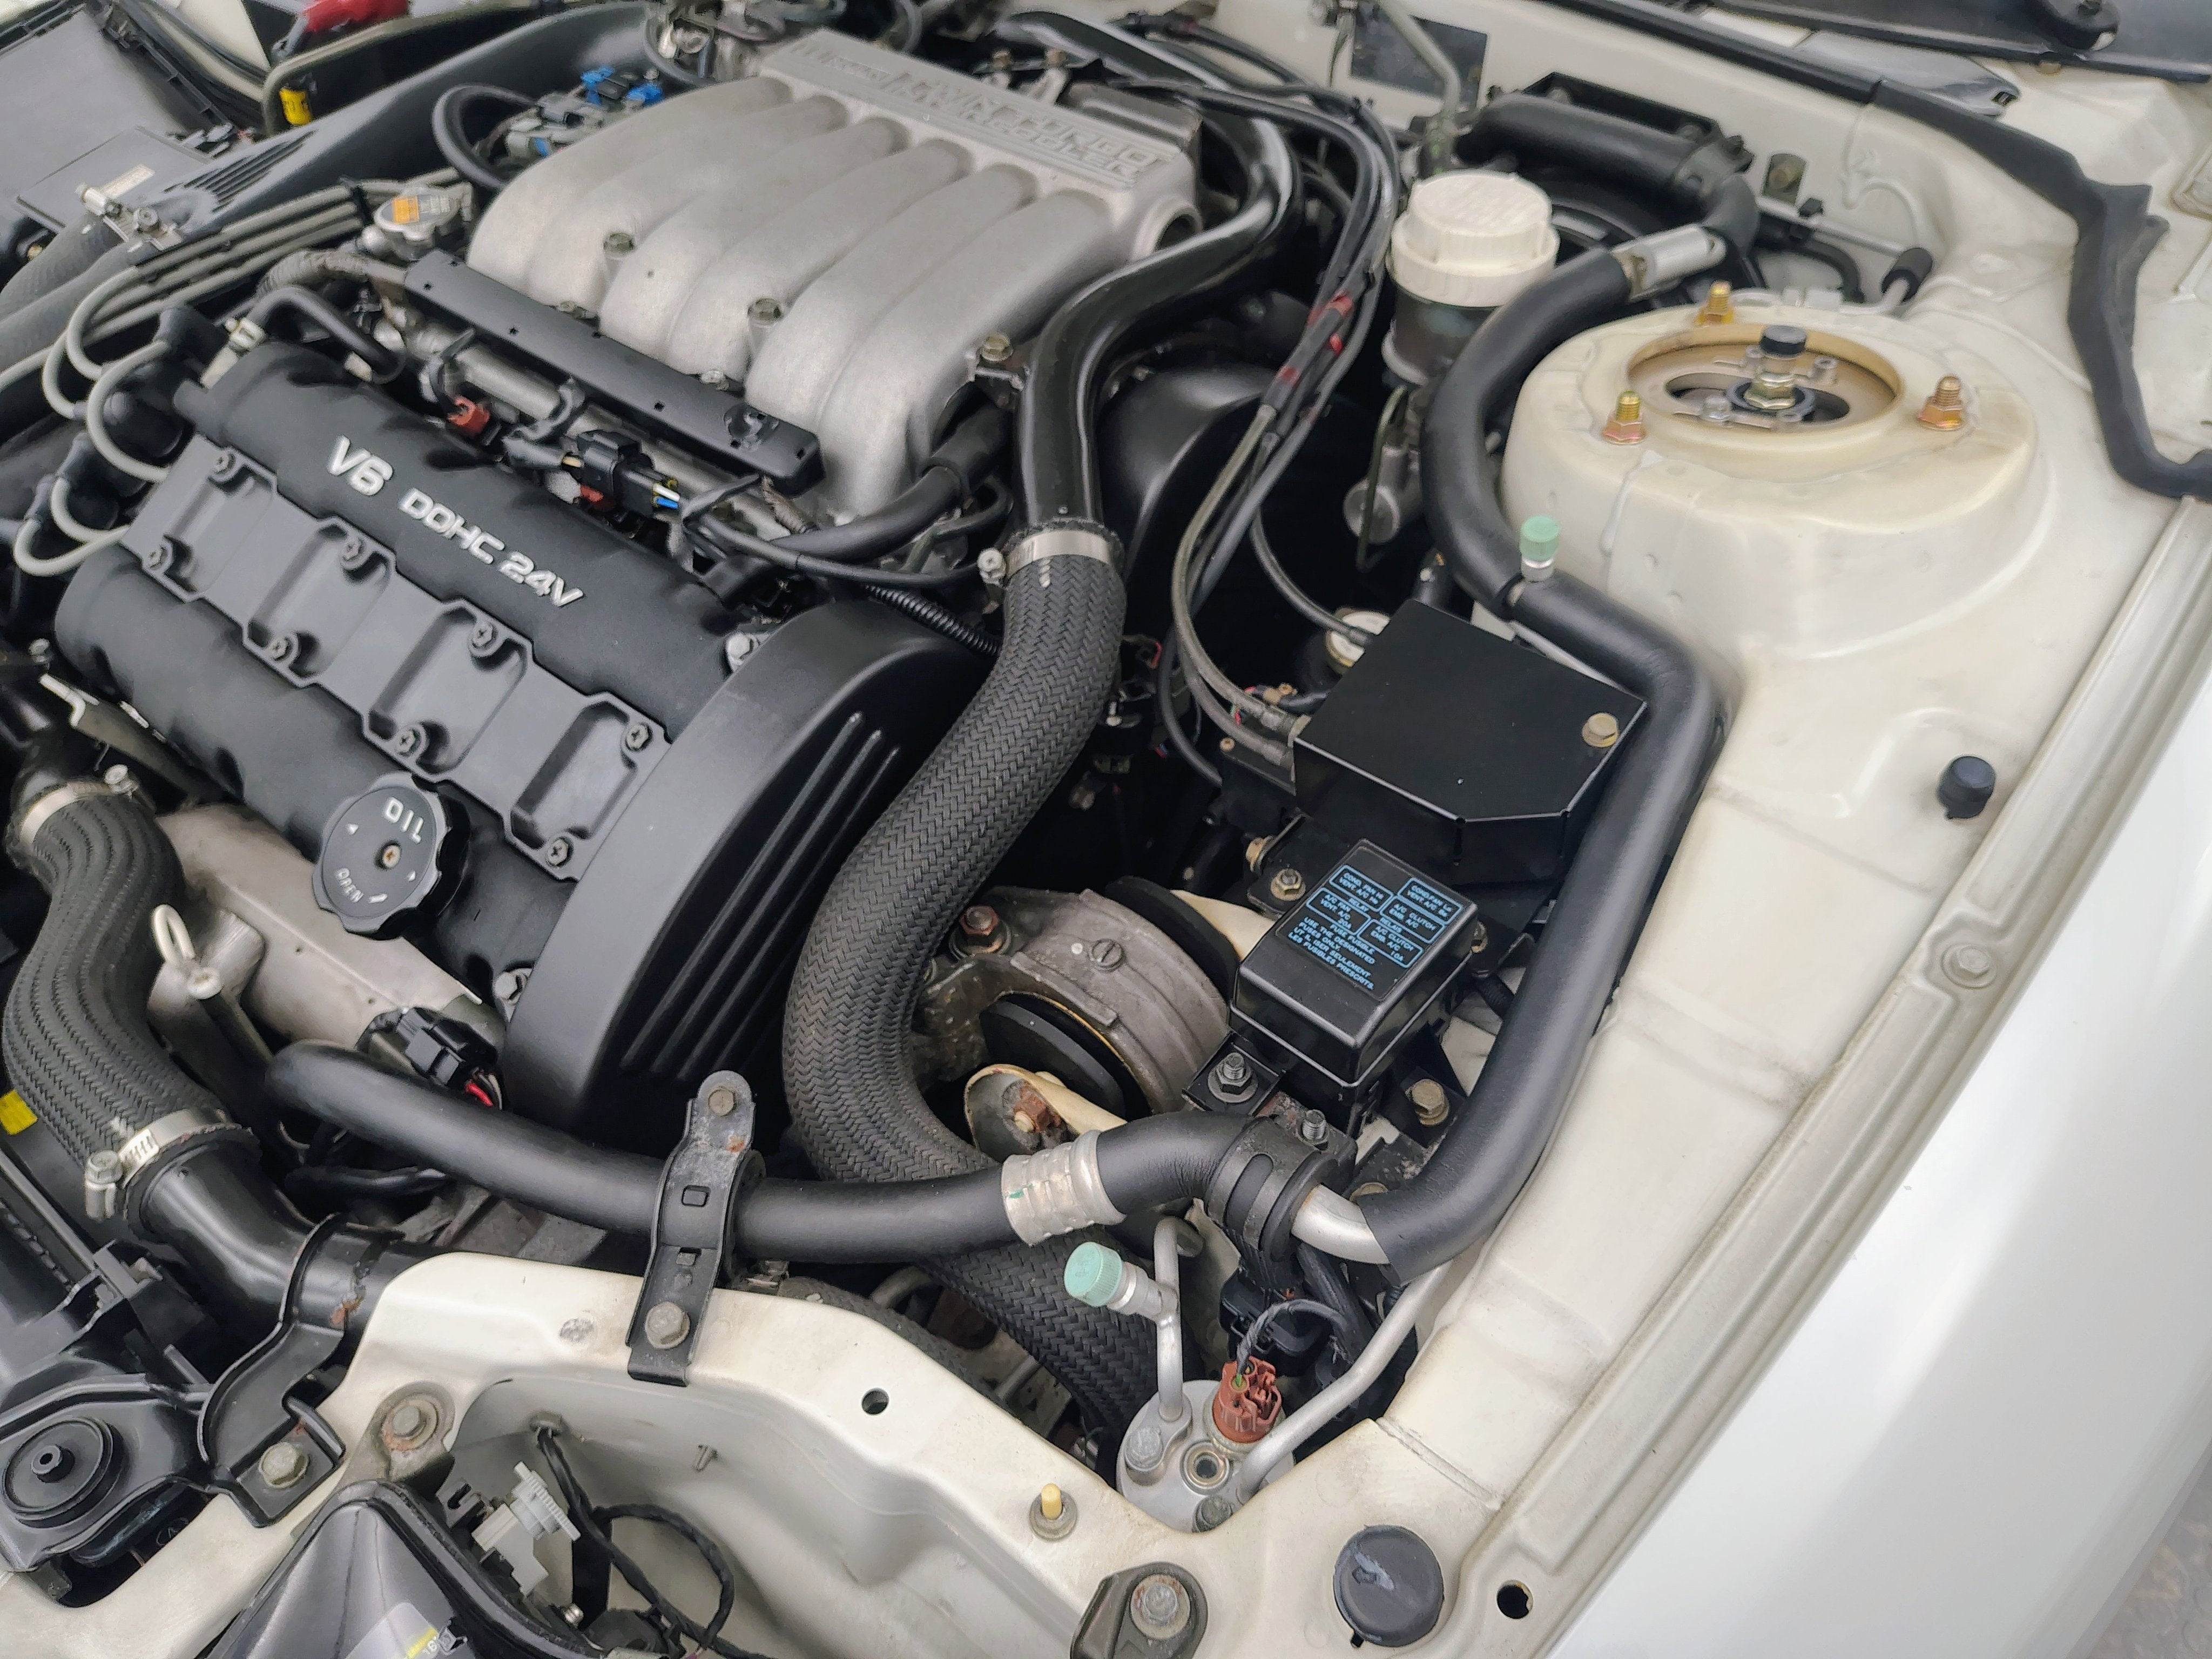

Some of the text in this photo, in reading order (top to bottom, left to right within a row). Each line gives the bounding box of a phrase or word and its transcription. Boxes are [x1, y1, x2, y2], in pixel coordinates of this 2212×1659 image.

[327, 434, 584, 608] V6 DOHC 24V
[385, 797, 424, 844] OIL
[336, 867, 364, 903] OPEN
[1355, 888, 1370, 899] A/C
[1363, 884, 1377, 895] FAN
[1324, 894, 1351, 913] A/C FAN
[1337, 910, 1351, 920] A/C
[1348, 897, 1405, 933] RELAY RELAIS
[1393, 903, 1437, 930] A/C CLUTCH
[1298, 921, 1321, 939] FUSES
[1405, 919, 1419, 929] A/C
[1288, 932, 1303, 943] LES
[1303, 941, 1337, 965] FUSIBLES
[1304, 916, 1375, 965] USE THE DESIGNATED
[1330, 923, 1375, 955] FUSE FUSIBLE
[1375, 926, 1414, 952] A/C CLUTCH
[1386, 941, 1401, 952] A/C
[1329, 950, 1371, 978] SEULEMENT
[1389, 950, 1404, 962] 10A
